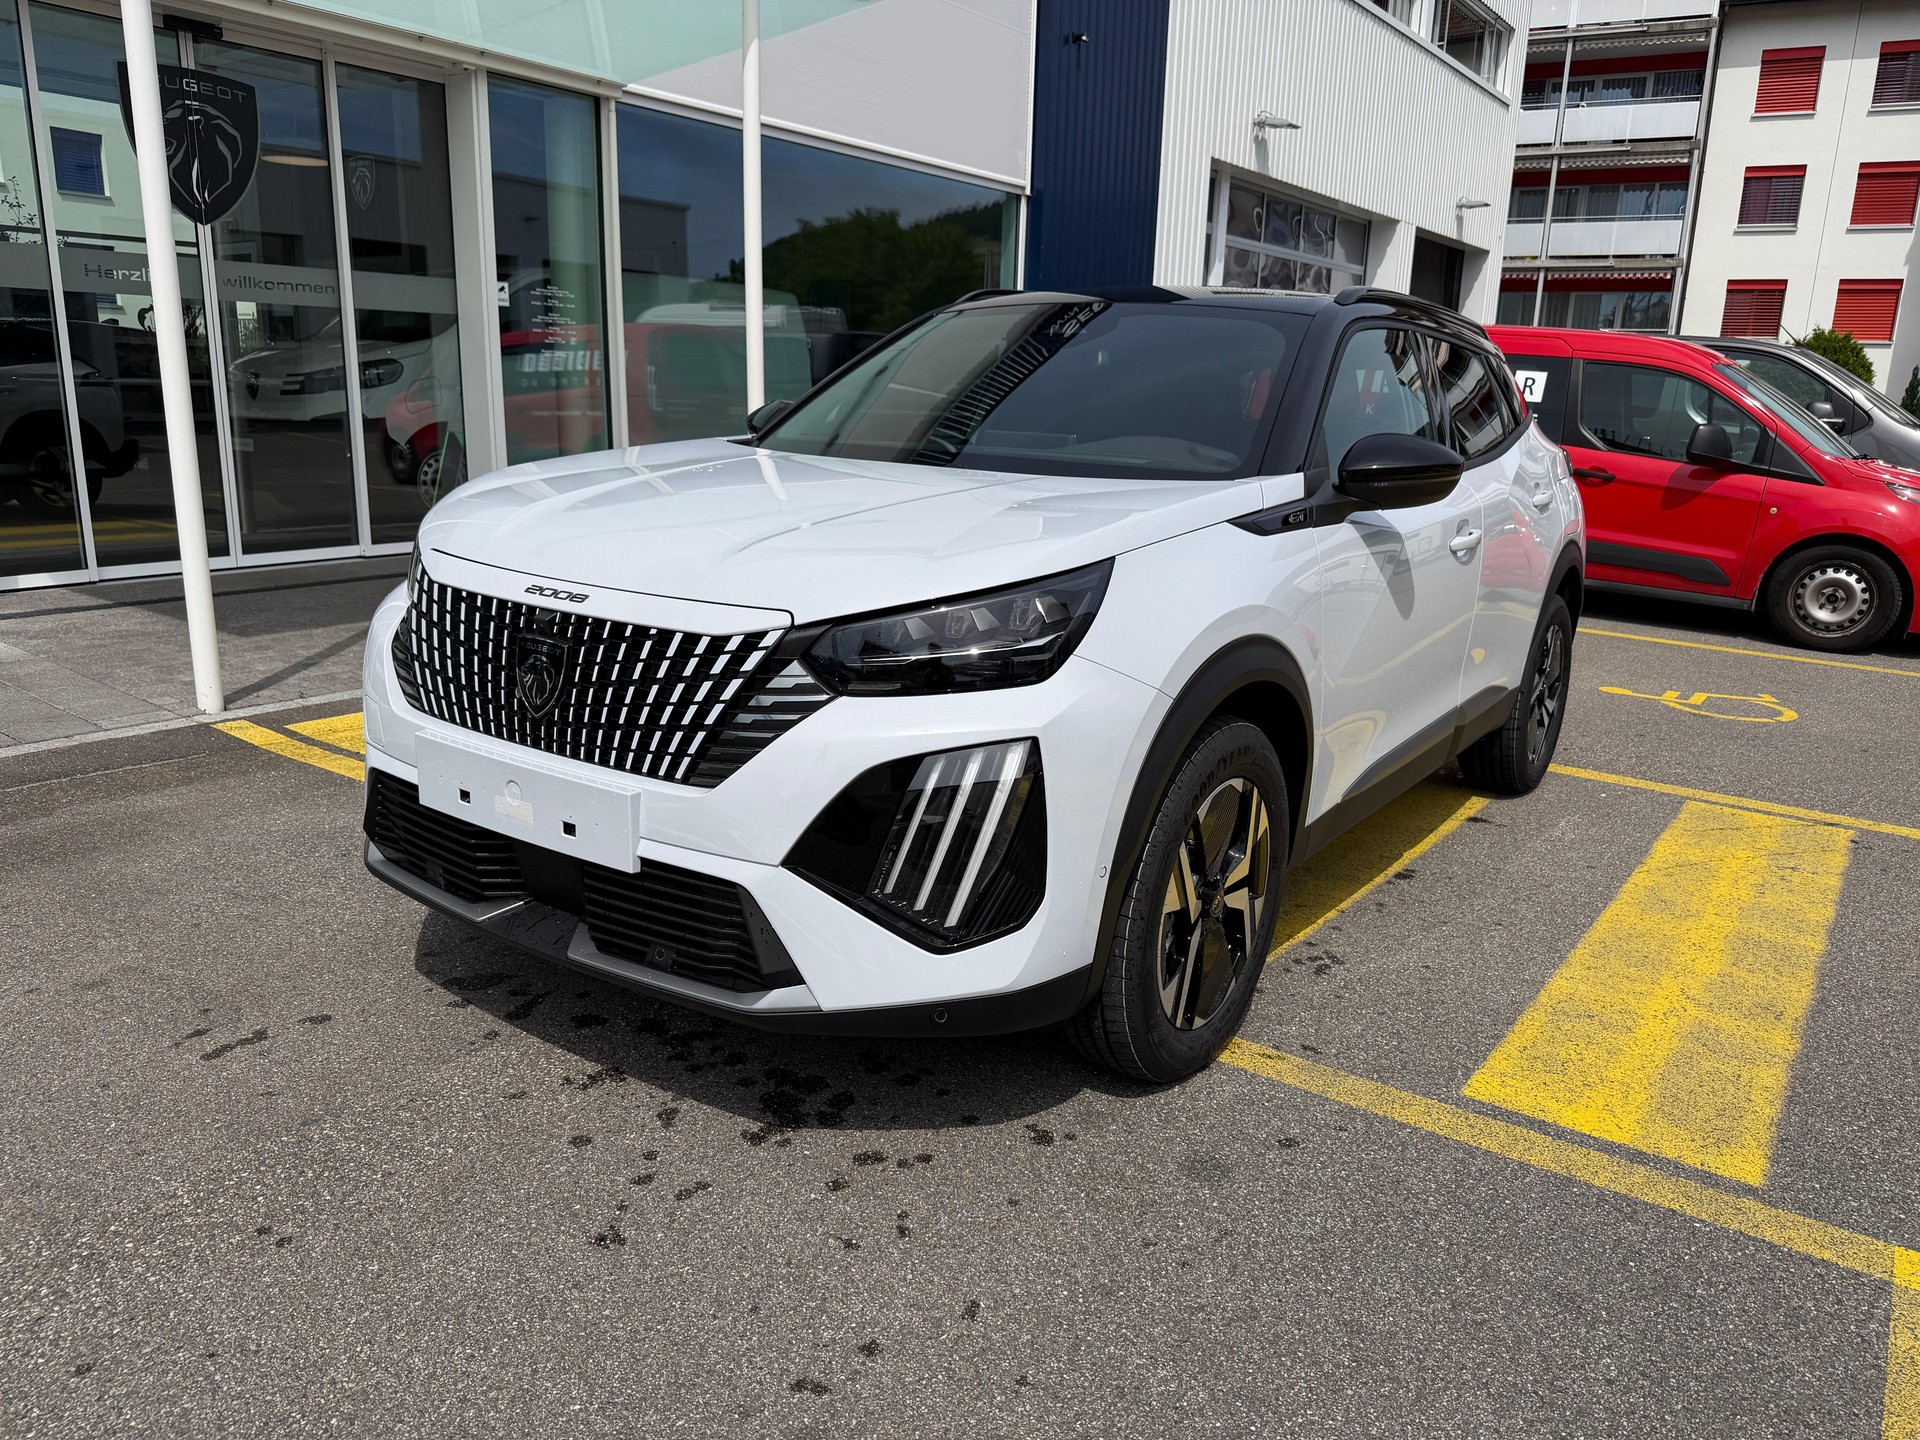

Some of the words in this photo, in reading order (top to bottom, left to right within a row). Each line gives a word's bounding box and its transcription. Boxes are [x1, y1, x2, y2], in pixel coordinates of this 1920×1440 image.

[158, 75, 247, 103] UGEOT
[84, 264, 151, 282] Herzli
[223, 275, 336, 295] willkommen
[524, 584, 590, 603] 2008
